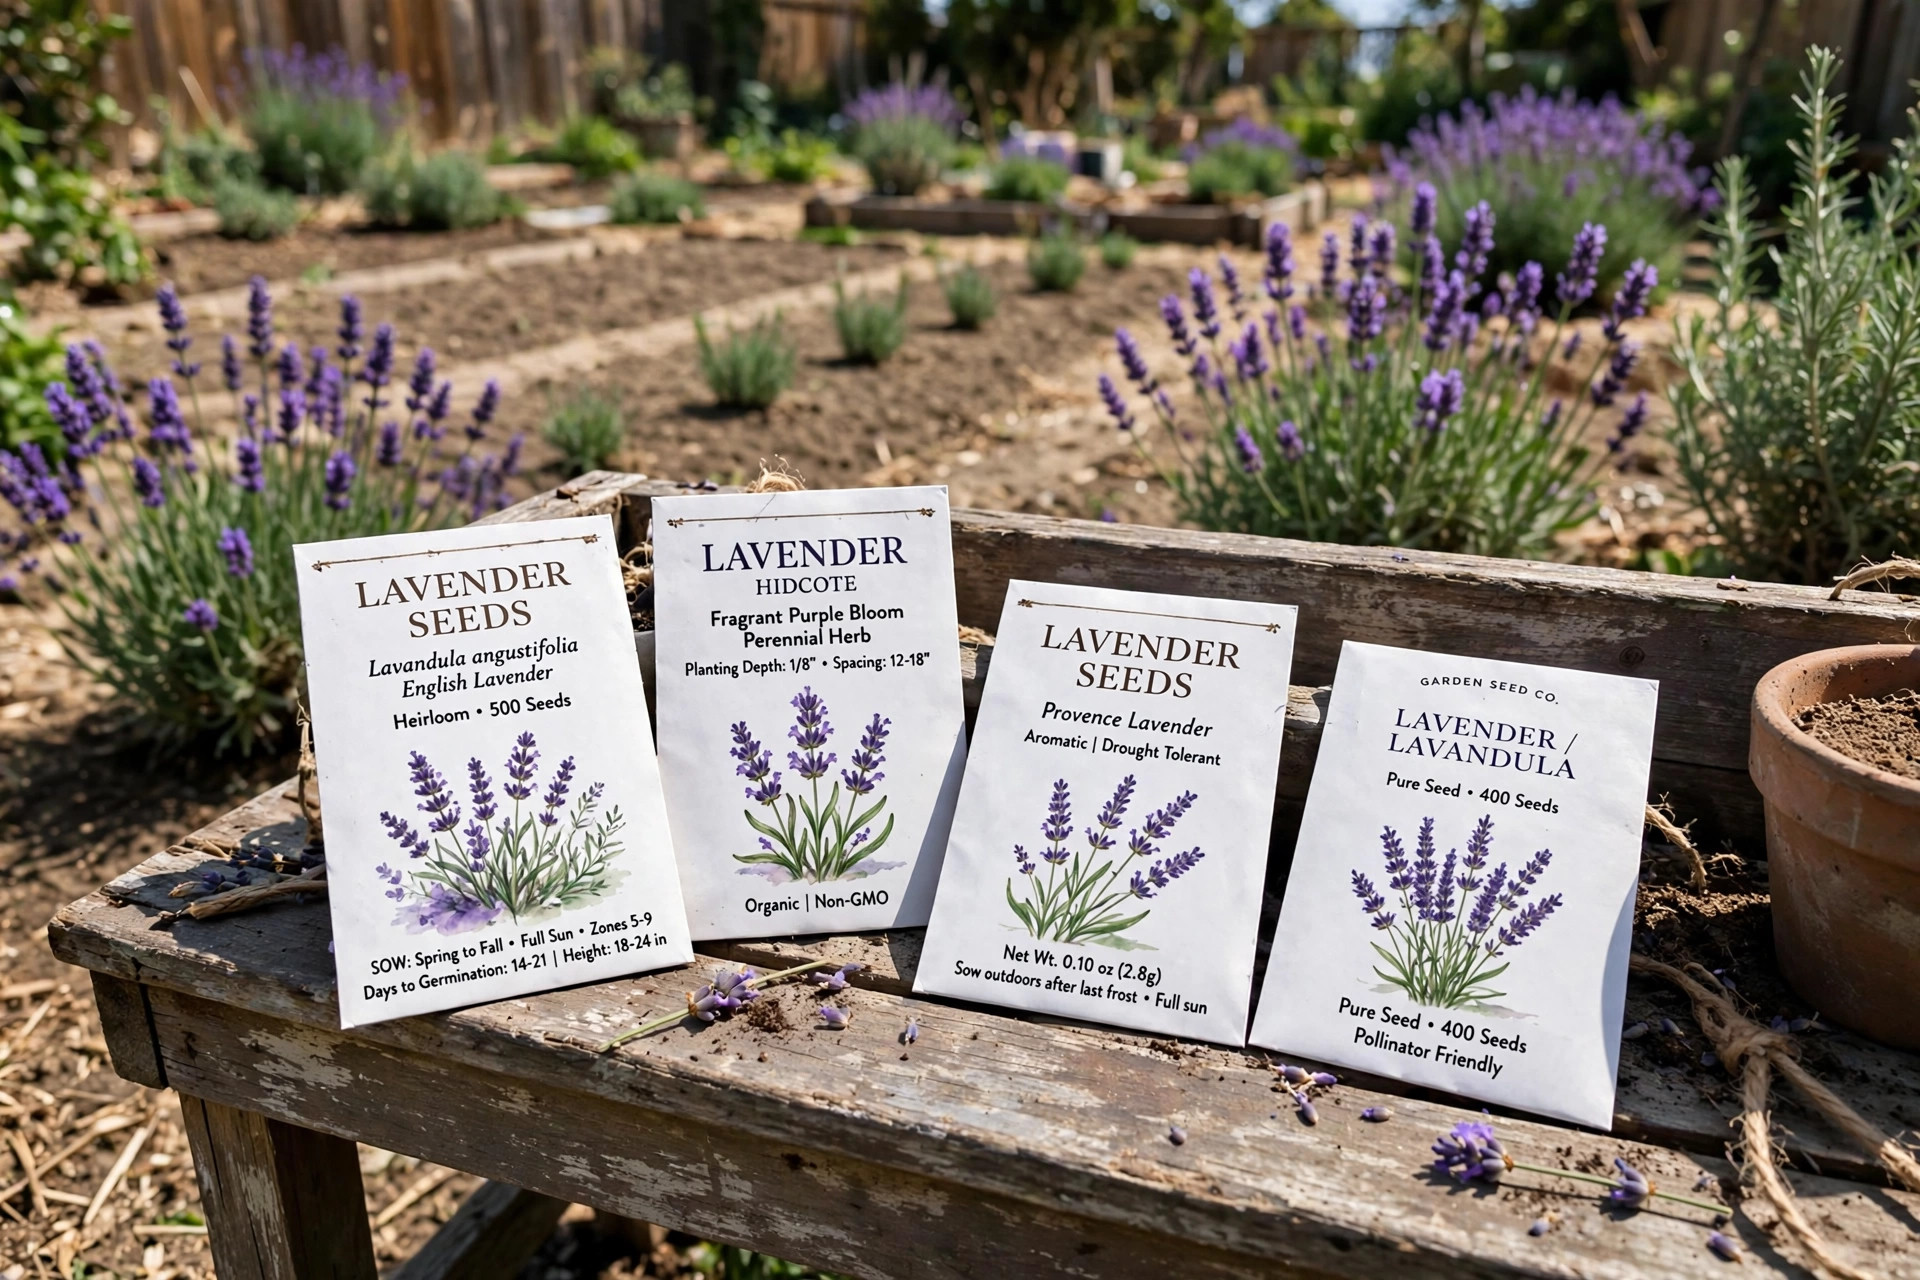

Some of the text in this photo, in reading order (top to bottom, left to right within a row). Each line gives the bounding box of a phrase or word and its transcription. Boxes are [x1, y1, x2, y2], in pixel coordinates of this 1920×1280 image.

[702, 536, 908, 572] LAVENDER
[355, 562, 571, 608] LAVENDER
[756, 575, 857, 595] HIDCOTE
[409, 600, 531, 638] SEEDS
[711, 603, 904, 631] Fragrant Purple Bloom
[744, 626, 871, 648] Perennial Herb
[1041, 624, 1240, 669] LAVENDER
[369, 636, 578, 677] Lavandula angustifolia
[685, 652, 930, 679] Planting Depth: 1/8" Spacing: 12-18"
[402, 664, 553, 700] English Lavender
[1076, 662, 1192, 698] SEEDS
[1420, 677, 1558, 704] GARDEN SEED CO.
[393, 692, 571, 730] Heirloom 500 Seeds
[1041, 701, 1213, 737] Provence Lavender
[1395, 708, 1556, 750] LAVENDER
[1024, 729, 1088, 749] Aromatic
[1102, 737, 1159, 761] Drought
[1164, 745, 1221, 766] Tolerant
[1388, 733, 1575, 779] LAVANDULA
[1386, 771, 1559, 814] Pure Seed 400 Seeds
[745, 896, 800, 917] Organic
[815, 890, 889, 909] Non-GMO
[371, 912, 652, 975] SOW: Spring to Fall Full Sun Zones 5-9
[364, 985, 398, 1002] Days
[401, 981, 415, 993] to
[418, 964, 508, 989] Germination:
[511, 953, 546, 972] 14-21
[563, 943, 611, 963] Height:
[614, 934, 652, 953] 18-24
[654, 933, 667, 946] in
[1003, 944, 1161, 988] Net Wt. 0.10 oz (2.8g)
[954, 960, 1207, 1015] Sow outdoors after last frost Full sun
[1339, 997, 1527, 1053] Pure Seed 400 Seeds
[1354, 1026, 1503, 1080] Pollinator Friendly
